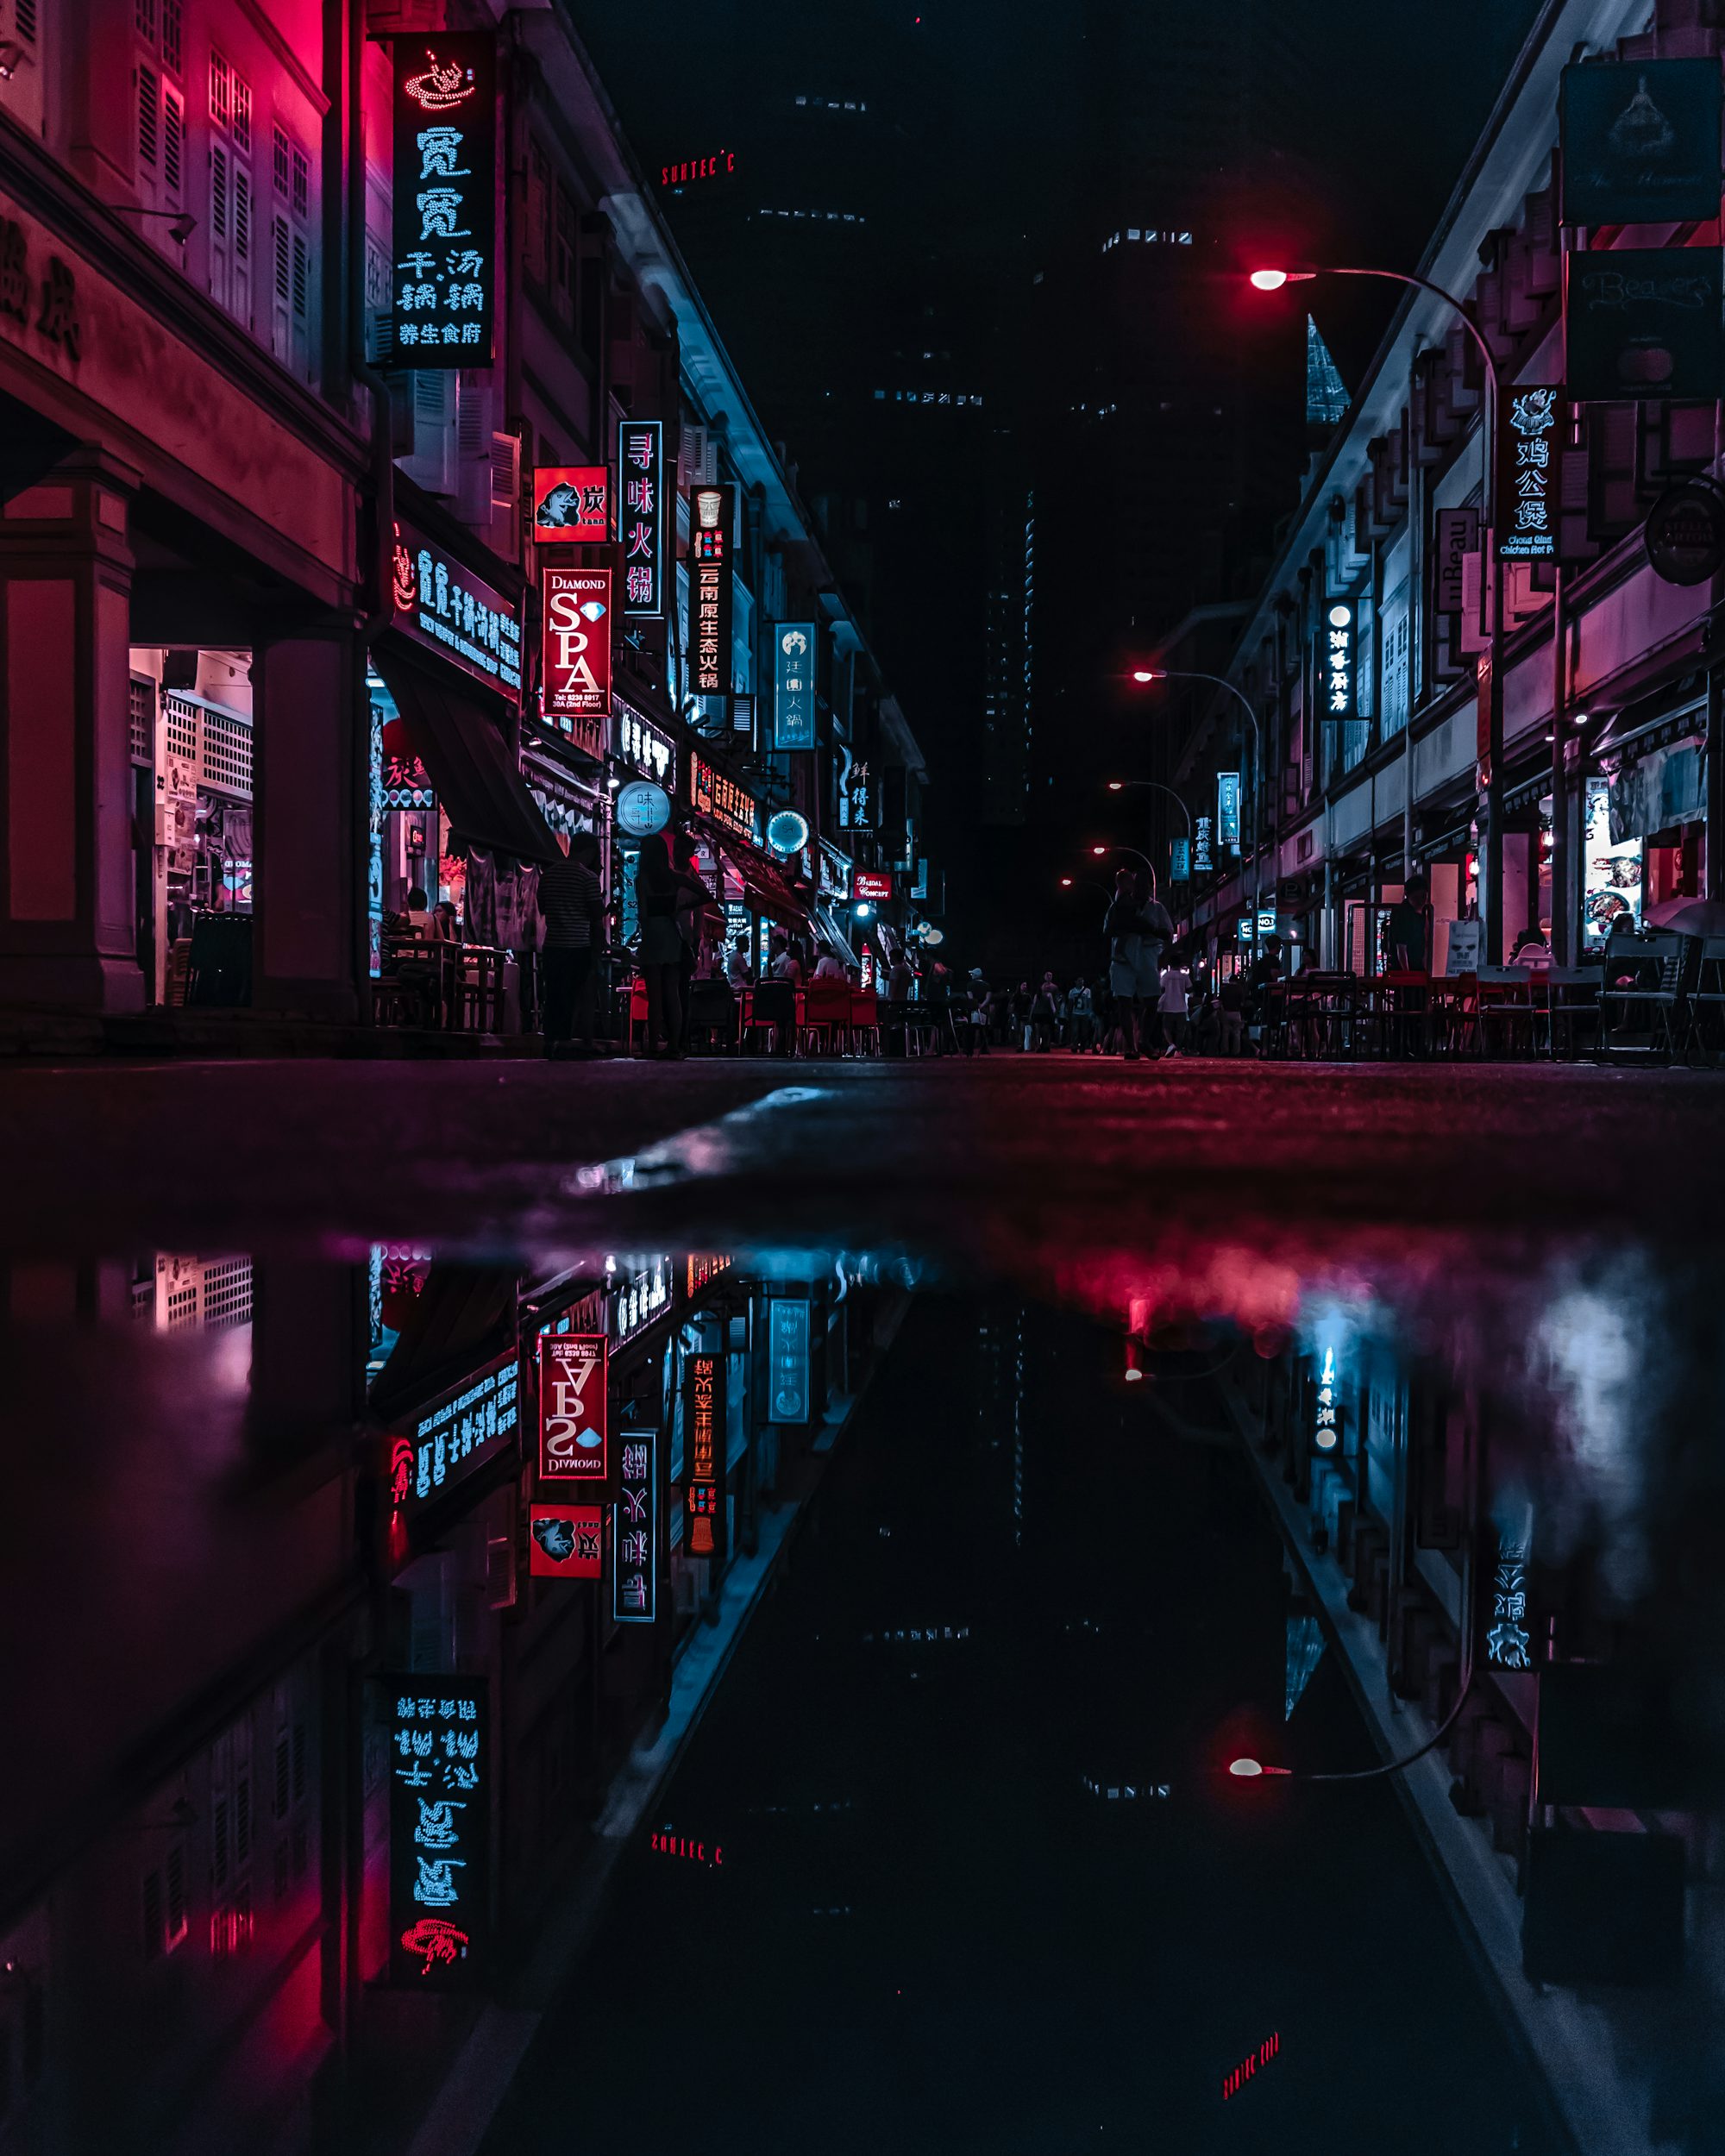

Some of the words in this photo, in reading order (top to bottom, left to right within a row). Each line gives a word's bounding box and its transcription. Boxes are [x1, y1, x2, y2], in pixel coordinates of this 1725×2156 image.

[581, 485, 605, 514] 炭
[627, 431, 654, 603] 寻味火锅
[1499, 545, 1530, 555] Chicken
[1530, 545, 1546, 555] Hot
[550, 575, 606, 591] DIAMOND
[698, 568, 719, 689] 云南原生态火锅
[549, 592, 605, 694] SPA
[566, 700, 581, 709] (2nd
[581, 700, 602, 709] Floor)
[856, 874, 883, 887] BRIDAL
[858, 886, 889, 898] CONCEPT
